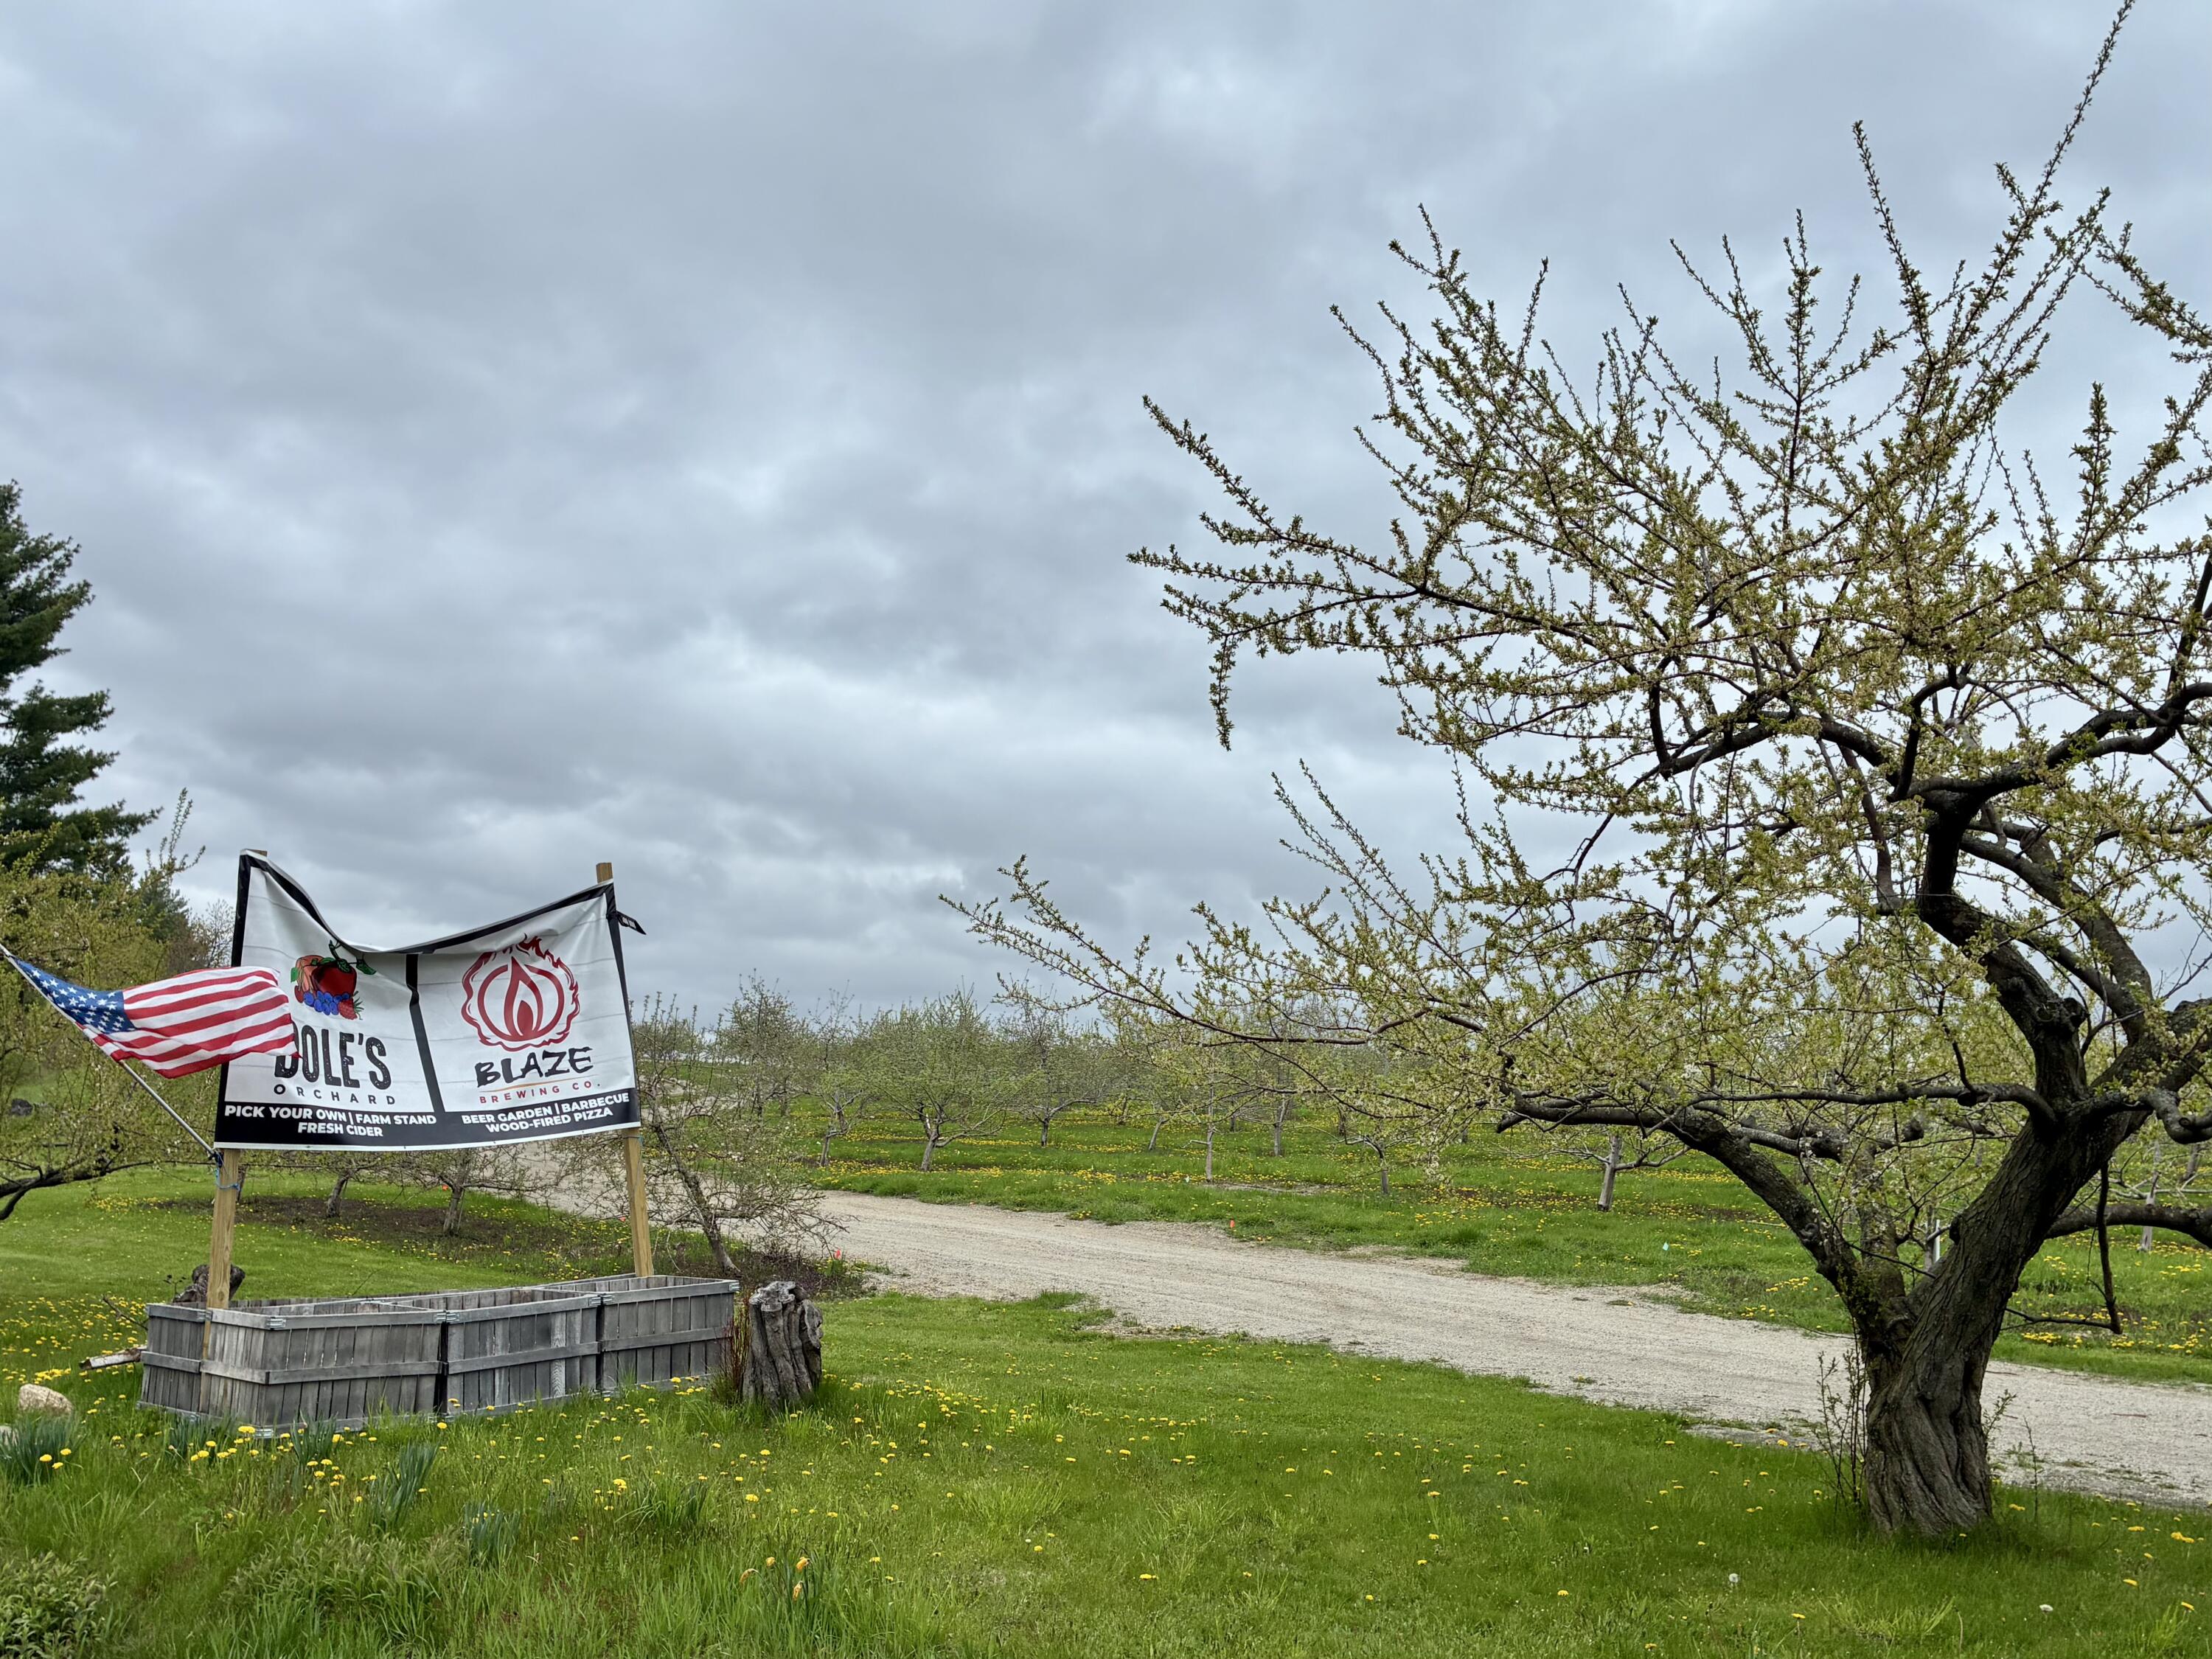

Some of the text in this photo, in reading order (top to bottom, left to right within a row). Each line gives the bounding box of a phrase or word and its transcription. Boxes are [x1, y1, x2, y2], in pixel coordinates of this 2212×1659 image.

[475, 1047, 594, 1088] BLAZE
[274, 1084, 395, 1105] ORCHARD
[479, 1081, 600, 1104] BREWING CO.
[224, 1105, 264, 1119] PICK
[269, 1106, 313, 1119] YOUR
[316, 1109, 347, 1122] OWN
[356, 1113, 392, 1124] FARM
[393, 1115, 437, 1124] STAND
[462, 1113, 495, 1124] BEER
[497, 1105, 553, 1122] GARDEN
[563, 1093, 630, 1113] BARBECUE
[485, 1107, 613, 1133] WOOD-FIRED PIZZA
[297, 1122, 383, 1137] FRESH CIDER
